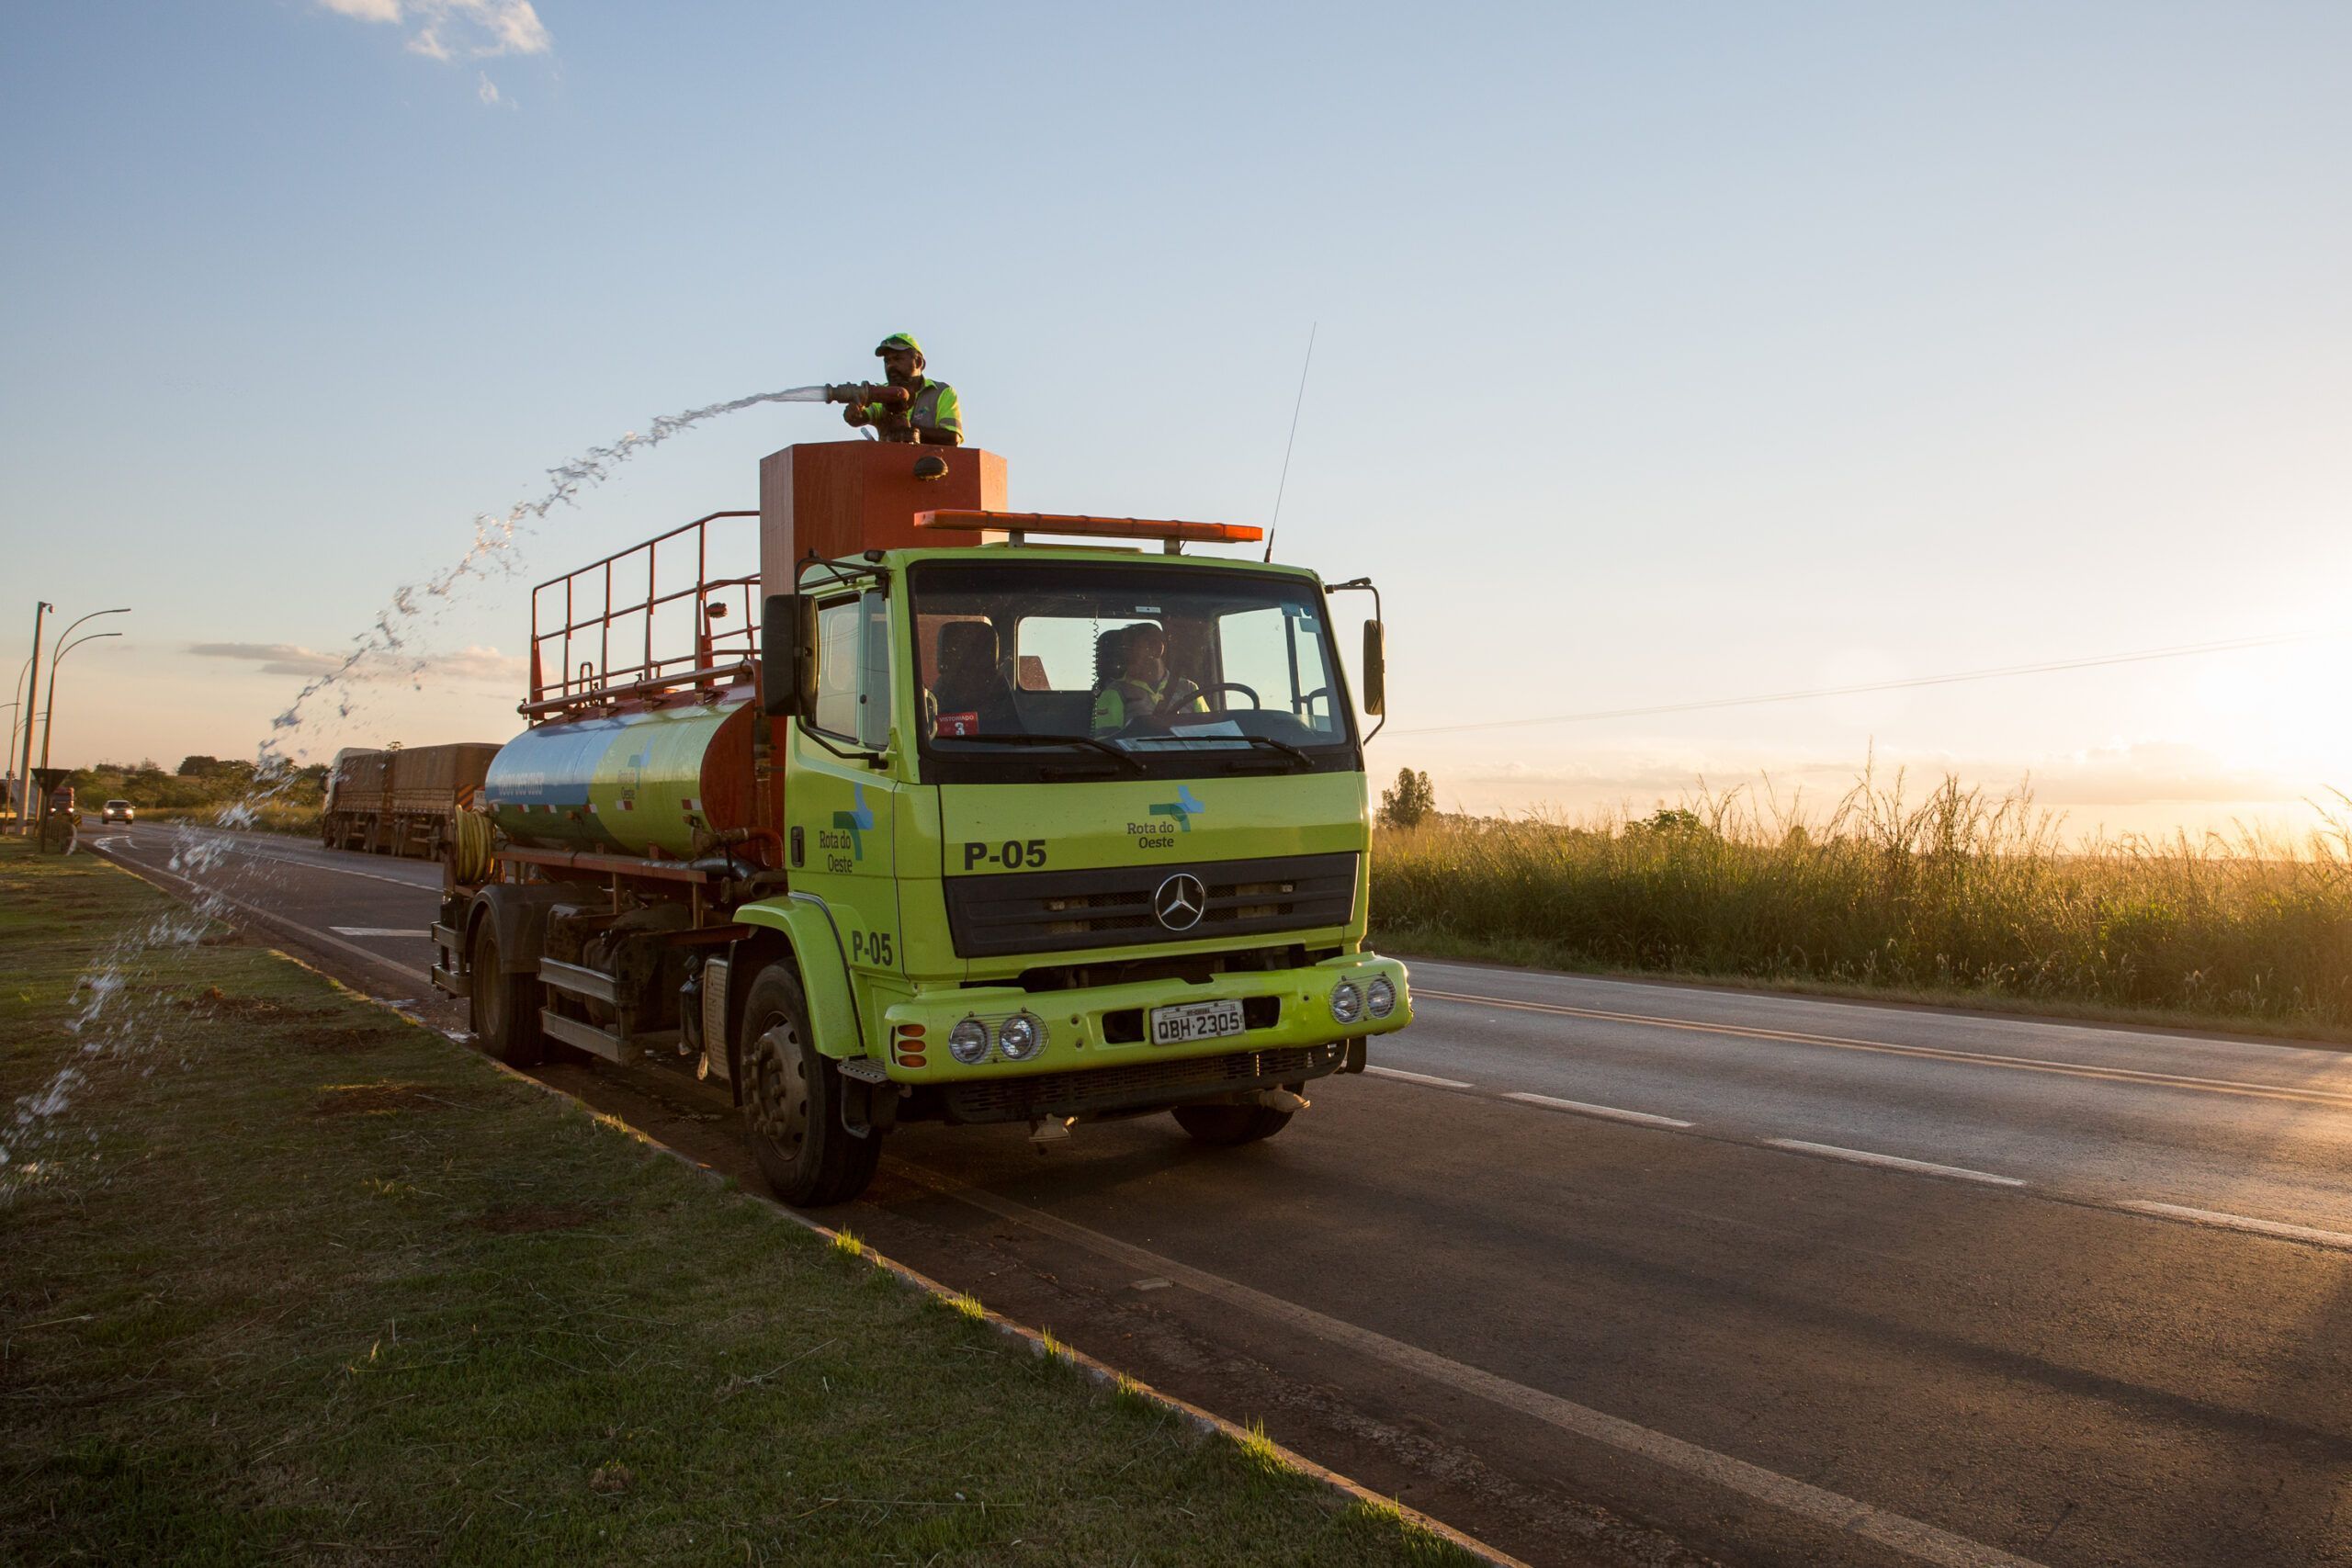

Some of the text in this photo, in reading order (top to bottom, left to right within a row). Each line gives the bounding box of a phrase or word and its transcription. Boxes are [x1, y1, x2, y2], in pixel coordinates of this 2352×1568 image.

[955, 722, 965, 736] 3
[1126, 821, 1174, 835] Rota do
[820, 829, 852, 850] Rota do
[1138, 836, 1174, 849] Oeste
[827, 853, 854, 873] Oeste
[965, 840, 1046, 871] P-05
[852, 931, 893, 965] P-05
